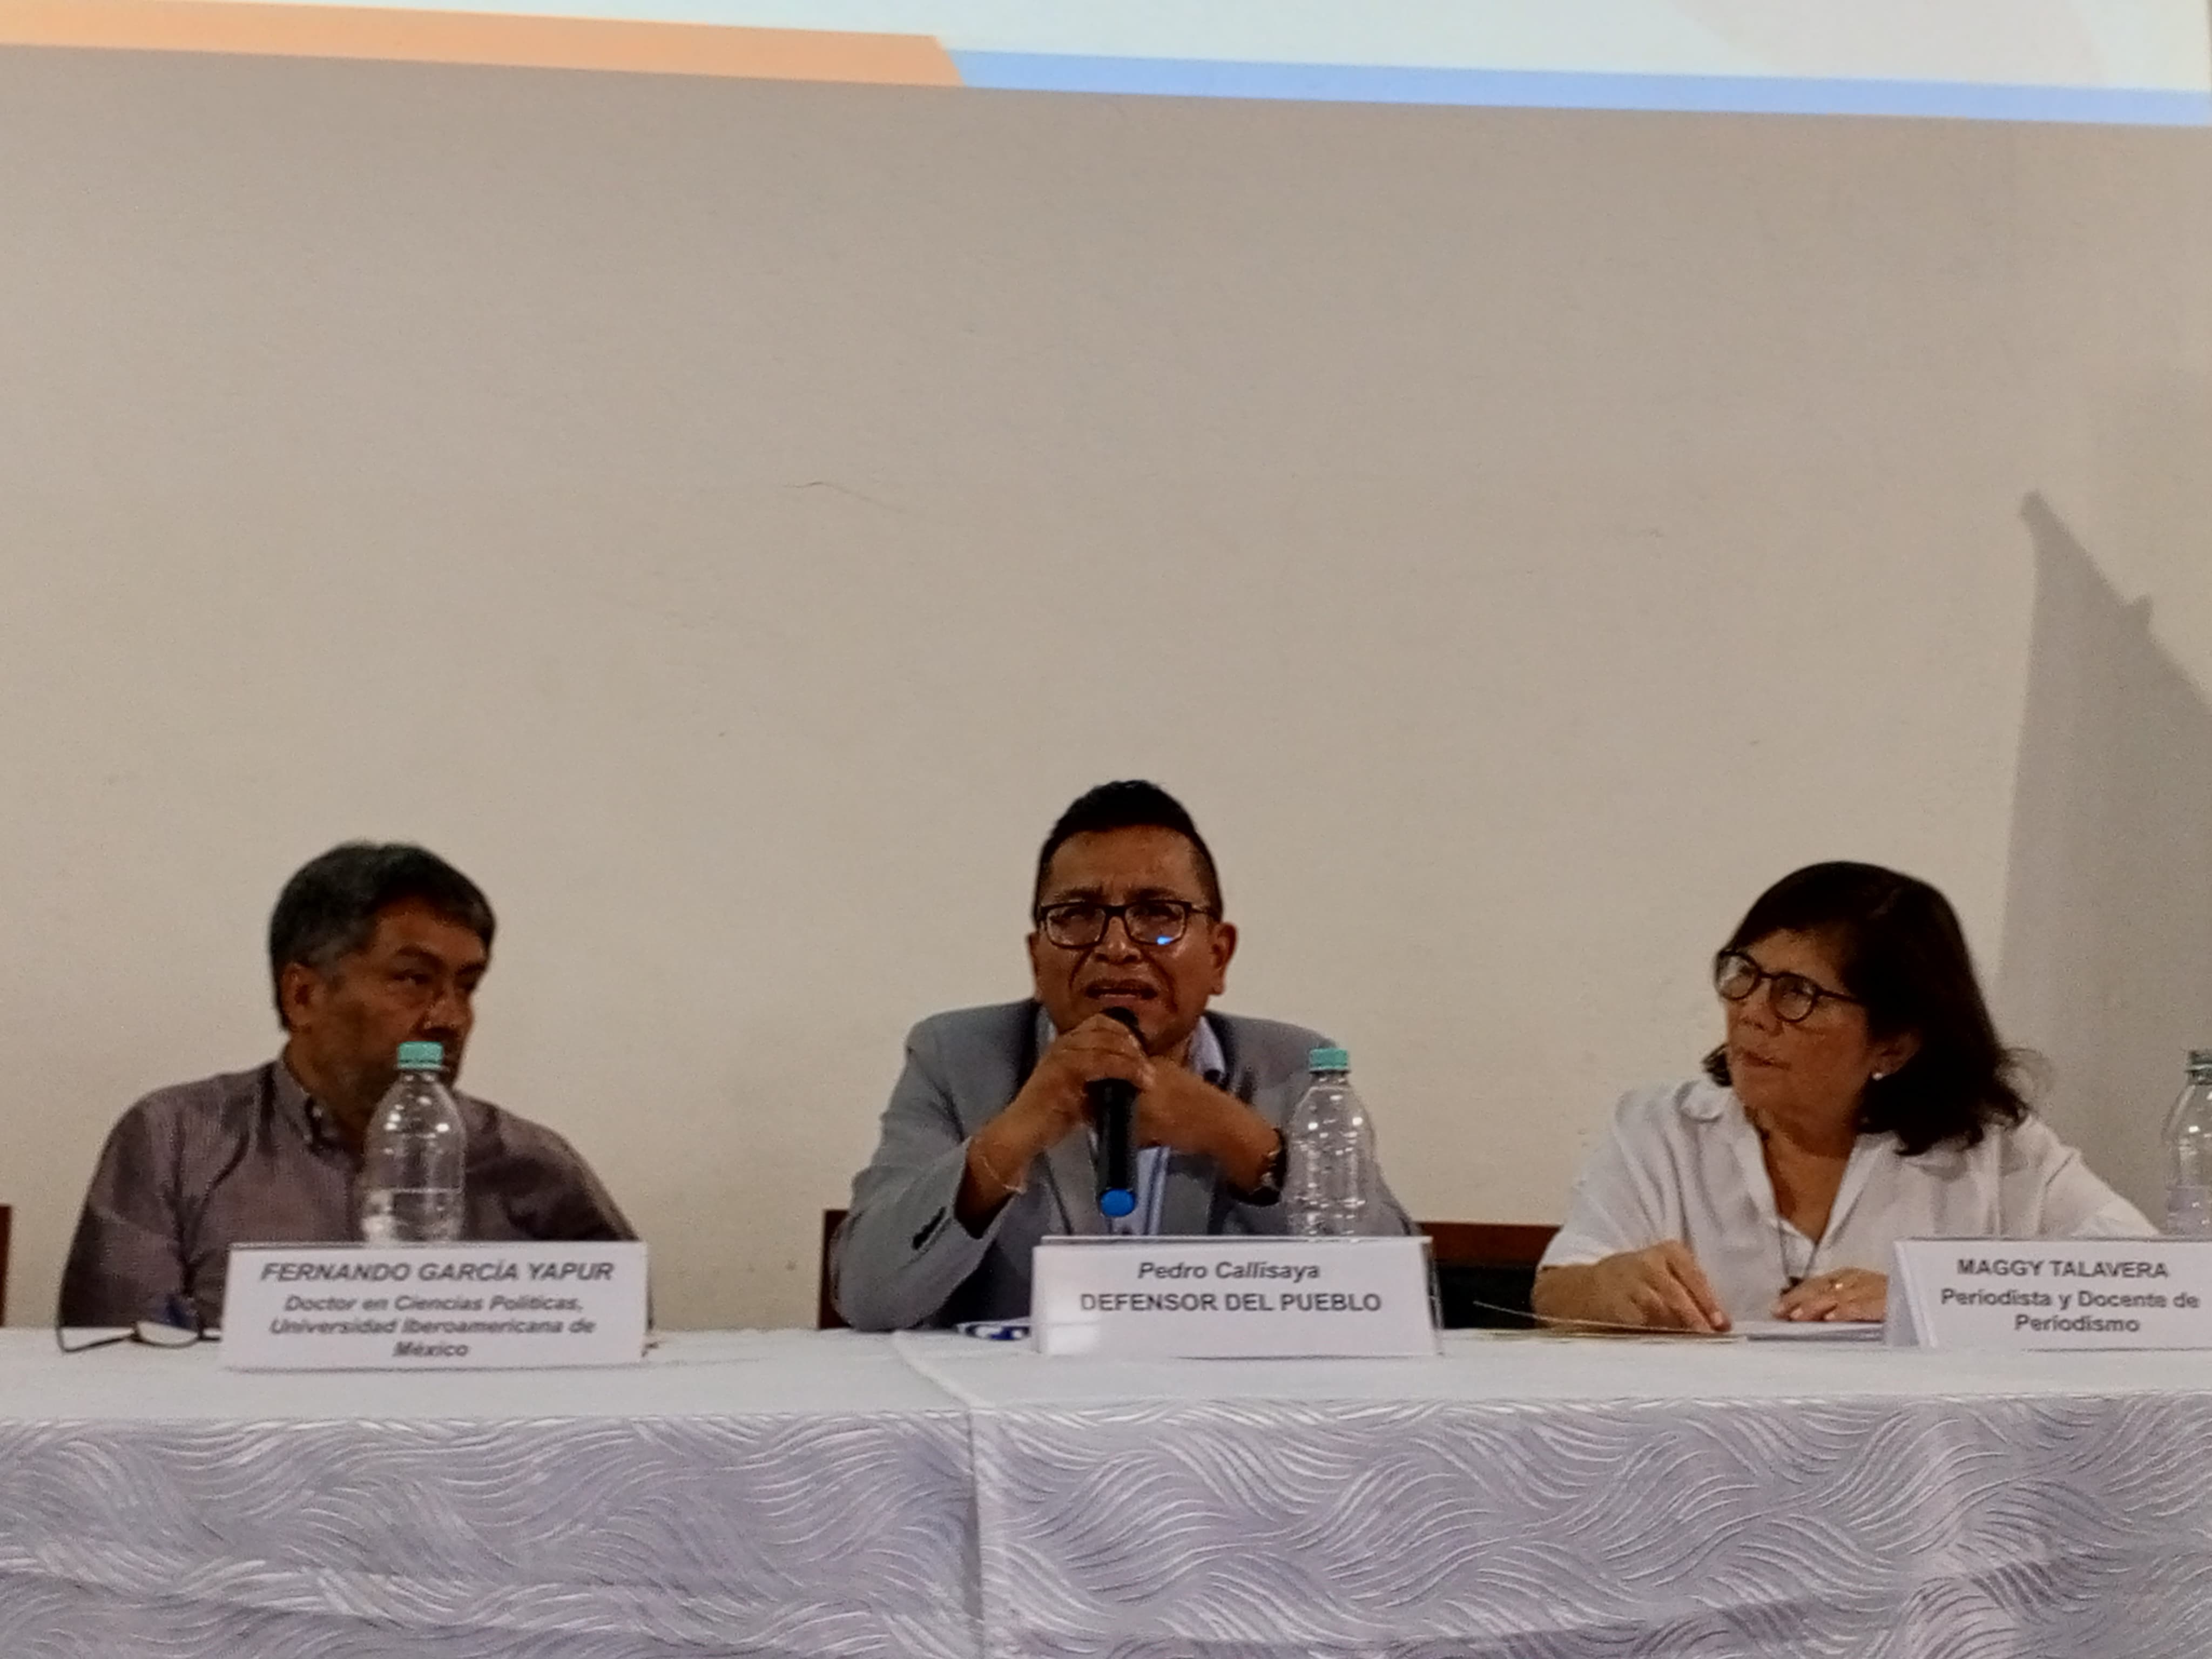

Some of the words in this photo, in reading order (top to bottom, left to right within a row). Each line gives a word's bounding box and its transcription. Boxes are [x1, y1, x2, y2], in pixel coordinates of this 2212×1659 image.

[260, 1262, 410, 1282] FERNANDO
[419, 1259, 518, 1282] GARCÍA
[528, 1262, 615, 1282] YAPUR
[1138, 1261, 1207, 1280] Pedro
[1215, 1260, 1320, 1283] Callisaya
[1957, 1259, 2044, 1277] MAGGY
[2051, 1260, 2169, 1278] TALAVERA
[284, 1296, 355, 1312] Doctor
[362, 1300, 388, 1312] en
[394, 1295, 483, 1312] Ciencias
[1081, 1294, 1219, 1312] DEFENSOR
[1224, 1294, 1274, 1312] DEL
[1280, 1294, 1382, 1312] PUEBLO
[1941, 1289, 2052, 1306] Periodista
[2058, 1292, 2072, 1310] y
[2078, 1291, 2167, 1307] Docente
[2173, 1292, 2200, 1308] de
[269, 1319, 399, 1335] Universidad
[401, 1318, 563, 1334] Iberoamericana
[568, 1318, 597, 1333] de
[2015, 1314, 2140, 1332] Periodismo
[392, 1339, 471, 1358] México
